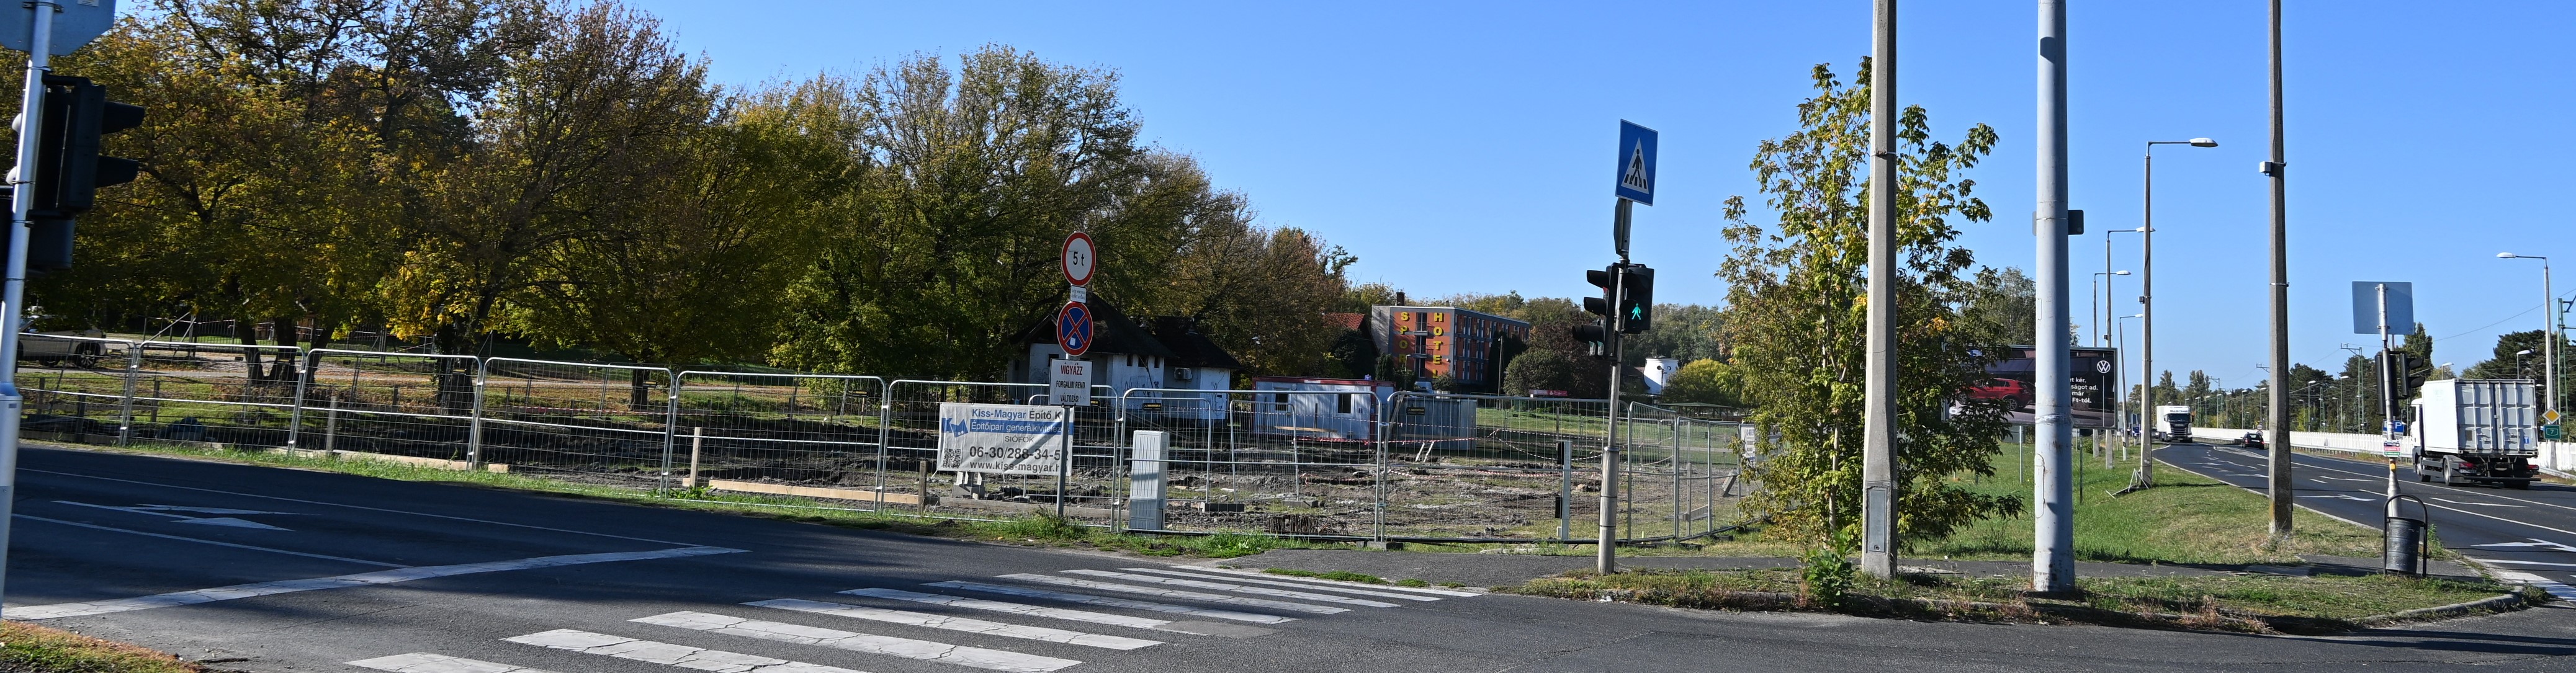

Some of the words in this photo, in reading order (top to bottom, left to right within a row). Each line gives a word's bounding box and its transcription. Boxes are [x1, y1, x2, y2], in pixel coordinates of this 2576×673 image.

[1073, 251, 1078, 265] 5
[1080, 253, 1085, 267] t
[1399, 311, 1409, 363] SPOR
[1432, 312, 1443, 379] HOTEL
[1061, 363, 1083, 375] VIGYÁZZ
[1056, 380, 1075, 388] FORGALMI
[1075, 381, 1085, 389] REND
[1060, 393, 1080, 403] VÁLTOZÁS!
[972, 408, 1026, 421] Kiss-Magyar
[1029, 408, 1052, 421] Építő
[971, 421, 1005, 432] Építőipari
[1004, 435, 1034, 443] SIÓFOK
[969, 446, 1069, 461] 06-30/288-34-5
[970, 461, 1060, 473] www.kiss-magyar.h
